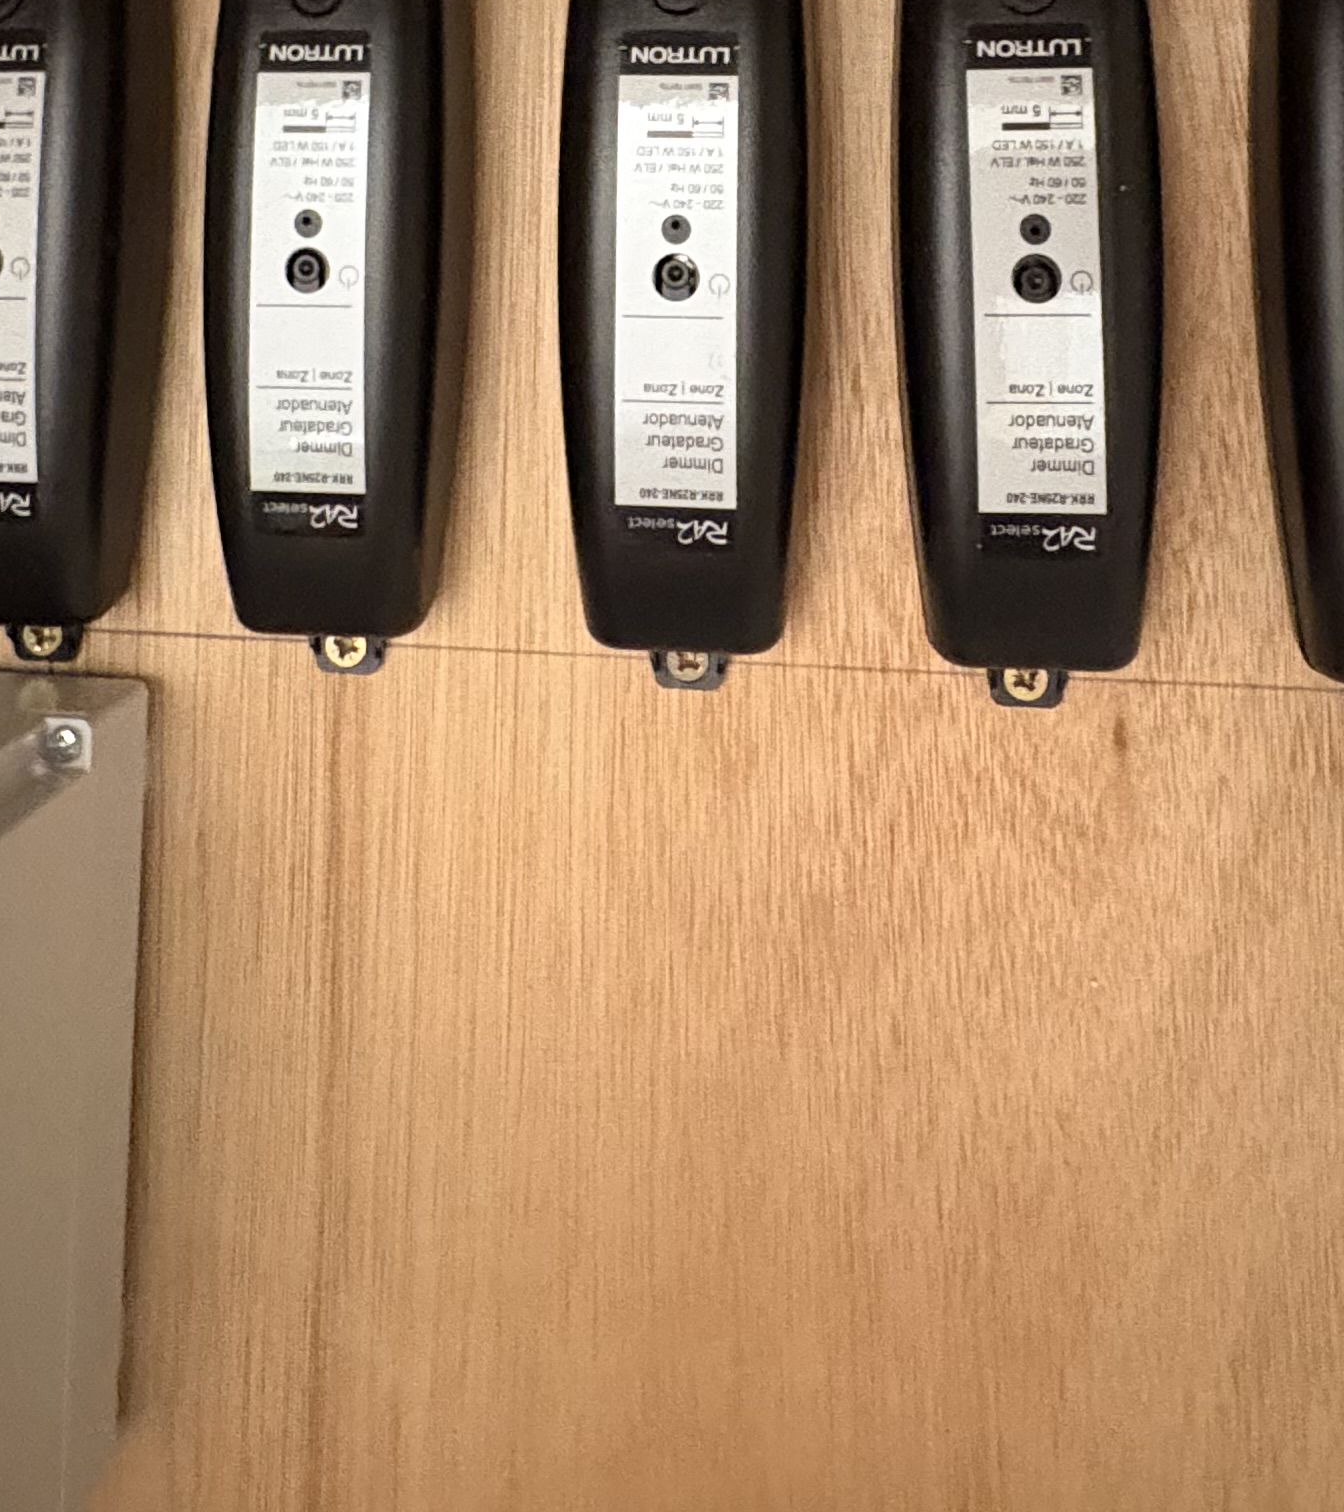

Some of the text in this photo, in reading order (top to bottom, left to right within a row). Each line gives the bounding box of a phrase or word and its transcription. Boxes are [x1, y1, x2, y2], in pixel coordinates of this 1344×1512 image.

[269, 44, 363, 61] LUTRON
[631, 47, 730, 63] LUTRON
[976, 39, 1082, 57] LUTRON
[1001, 105, 1040, 116] 5 mm
[1058, 384, 1093, 397] Zone
[276, 399, 352, 415] Atenuador
[278, 420, 352, 436] Gradateur
[644, 413, 724, 429] Atenuador
[1008, 415, 1094, 430] Atenuador
[296, 441, 352, 457] Dimmer
[645, 436, 724, 451] Gradateur
[1012, 437, 1094, 452] Gradateur
[663, 457, 723, 473] Dimmer
[1031, 460, 1094, 475] Dimmer
[310, 504, 358, 528] RA2
[677, 519, 728, 544] RA2
[1042, 526, 1095, 550] RA2
